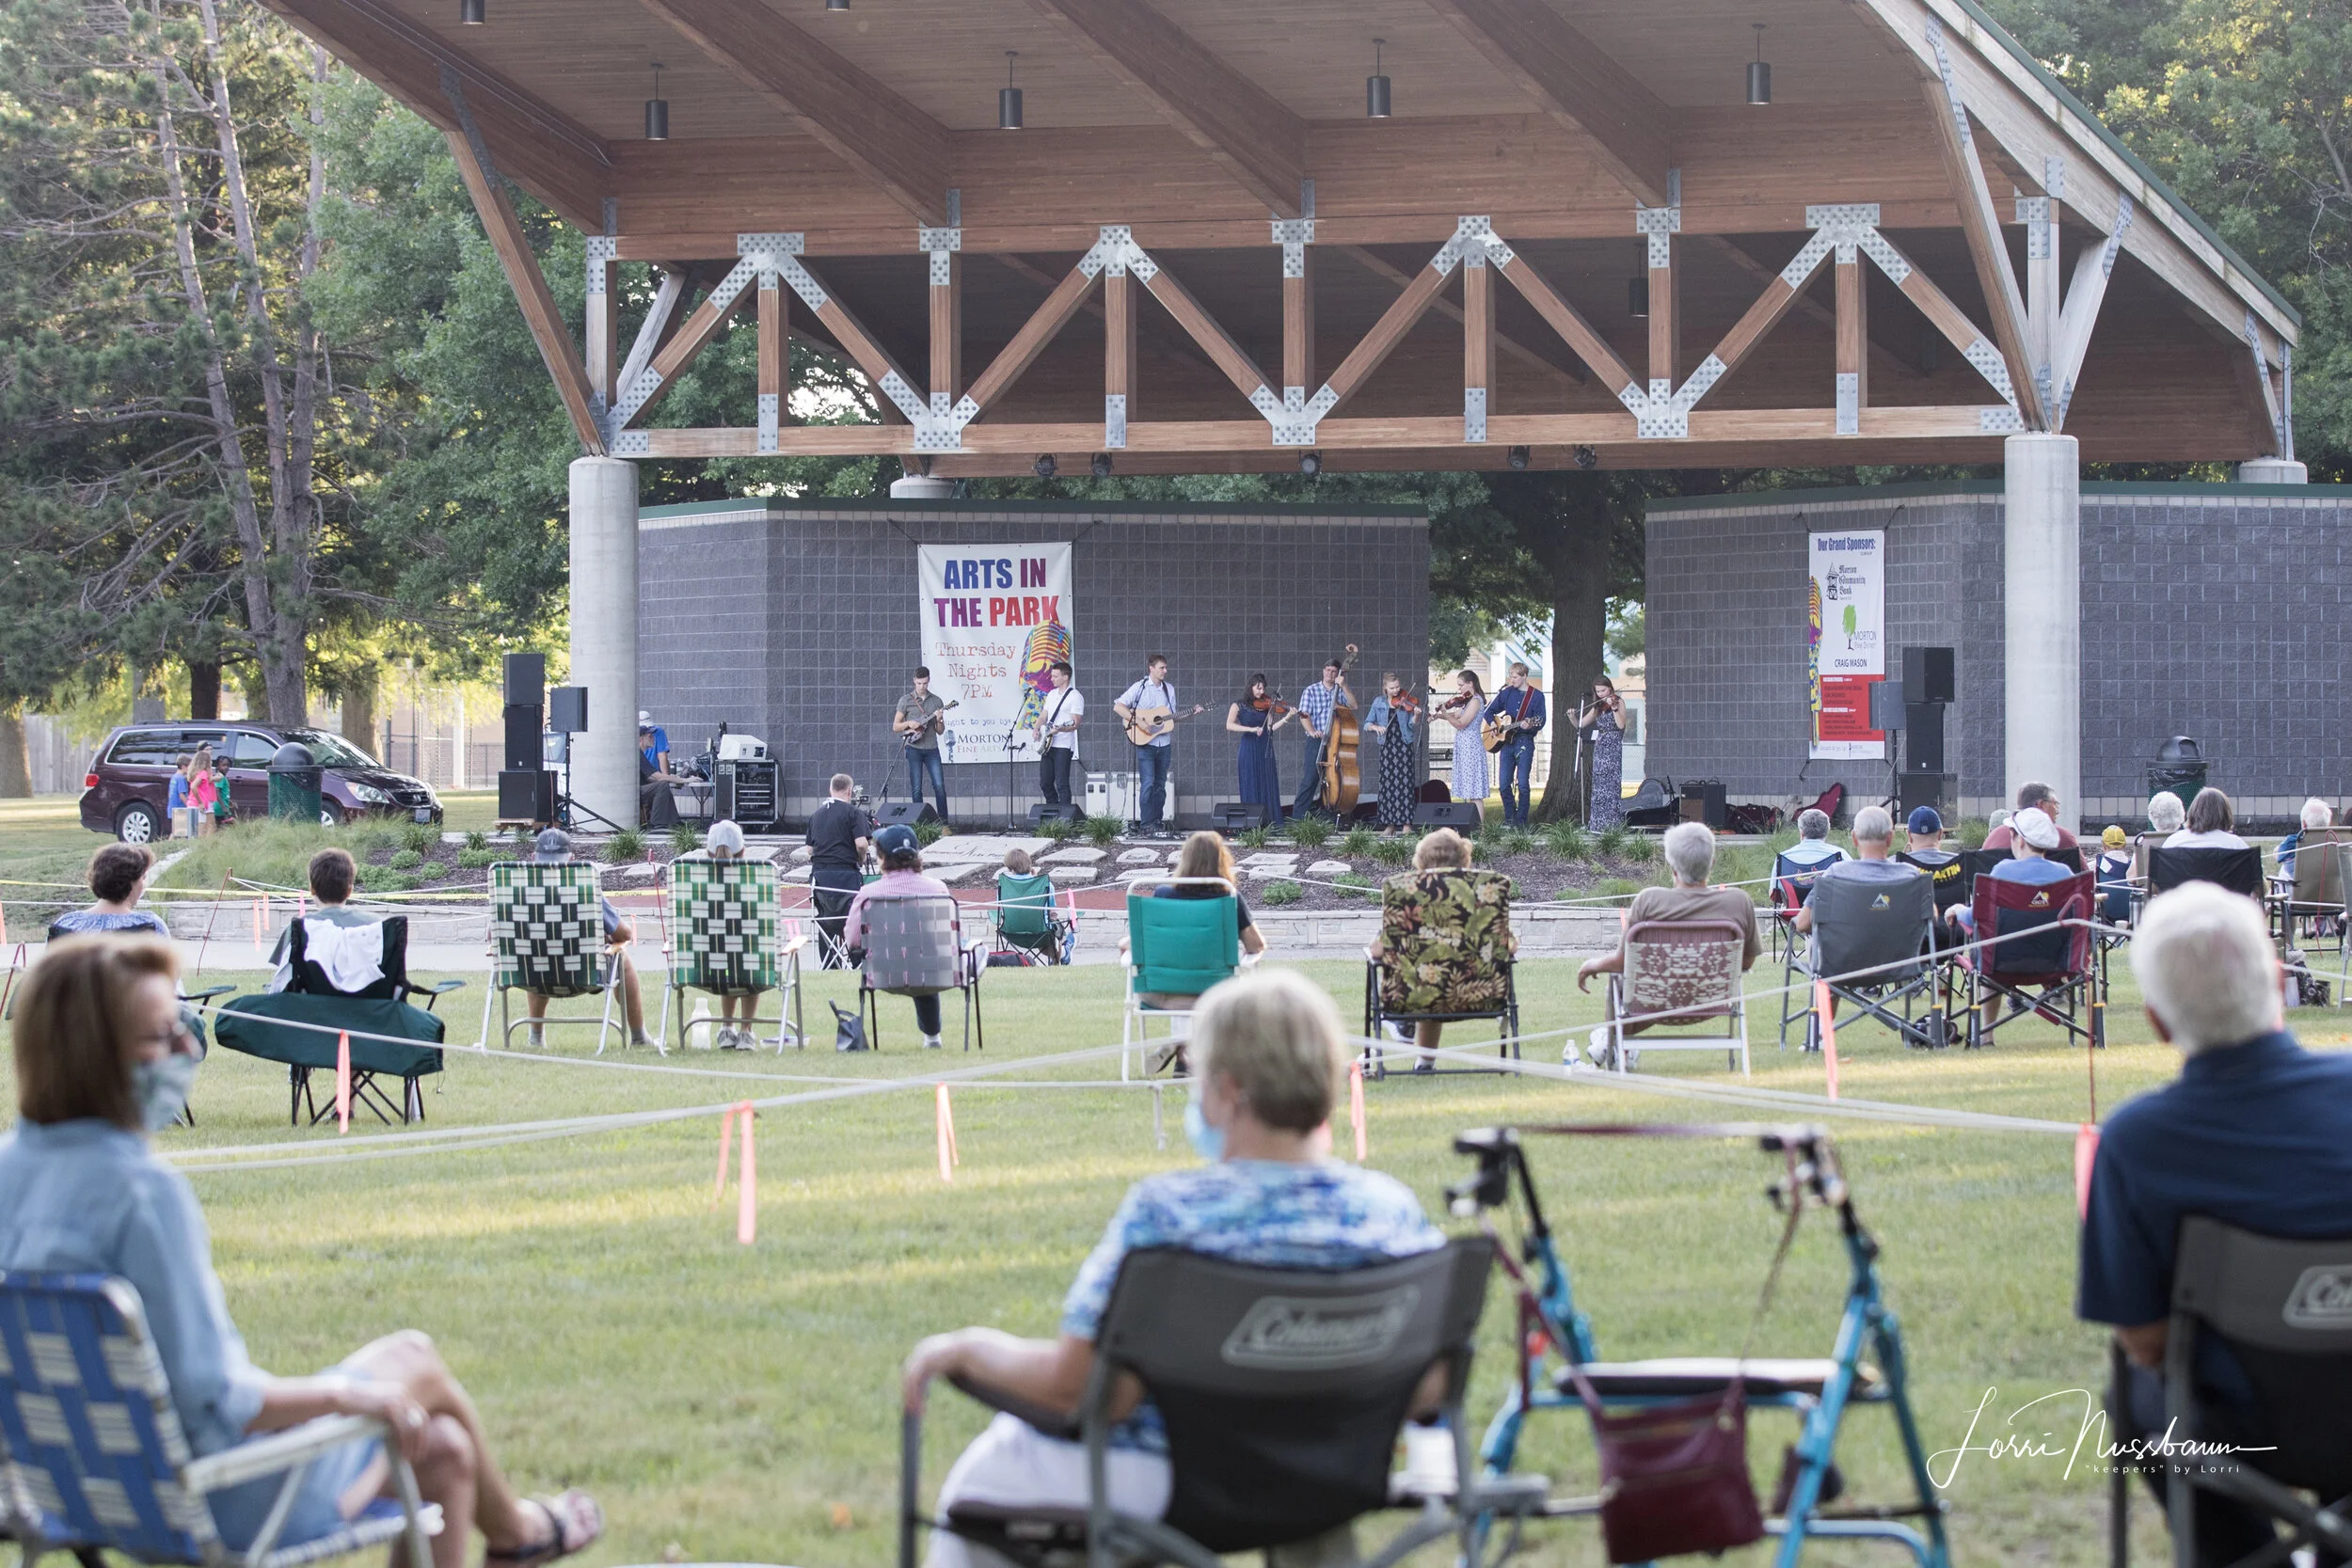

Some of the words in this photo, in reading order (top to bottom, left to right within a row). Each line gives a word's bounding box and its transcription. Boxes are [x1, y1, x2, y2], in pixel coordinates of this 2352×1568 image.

[1818, 538, 1827, 551] Our
[1829, 537, 1845, 551] Grand
[1847, 536, 1876, 551] Sponsors:
[944, 558, 1012, 590] ARTS
[1020, 558, 1046, 588] IN
[1839, 564, 1857, 574] Morton
[933, 597, 982, 627] THE
[989, 595, 1059, 626] PARK
[1853, 631, 1877, 641] MORTON
[935, 641, 1016, 659] Thursday
[1835, 658, 1849, 668] CRAIG
[1850, 658, 1867, 668] MASON
[948, 662, 1007, 680] Nights
[961, 684, 993, 700] 7PM
[958, 734, 1009, 744] MORTON
